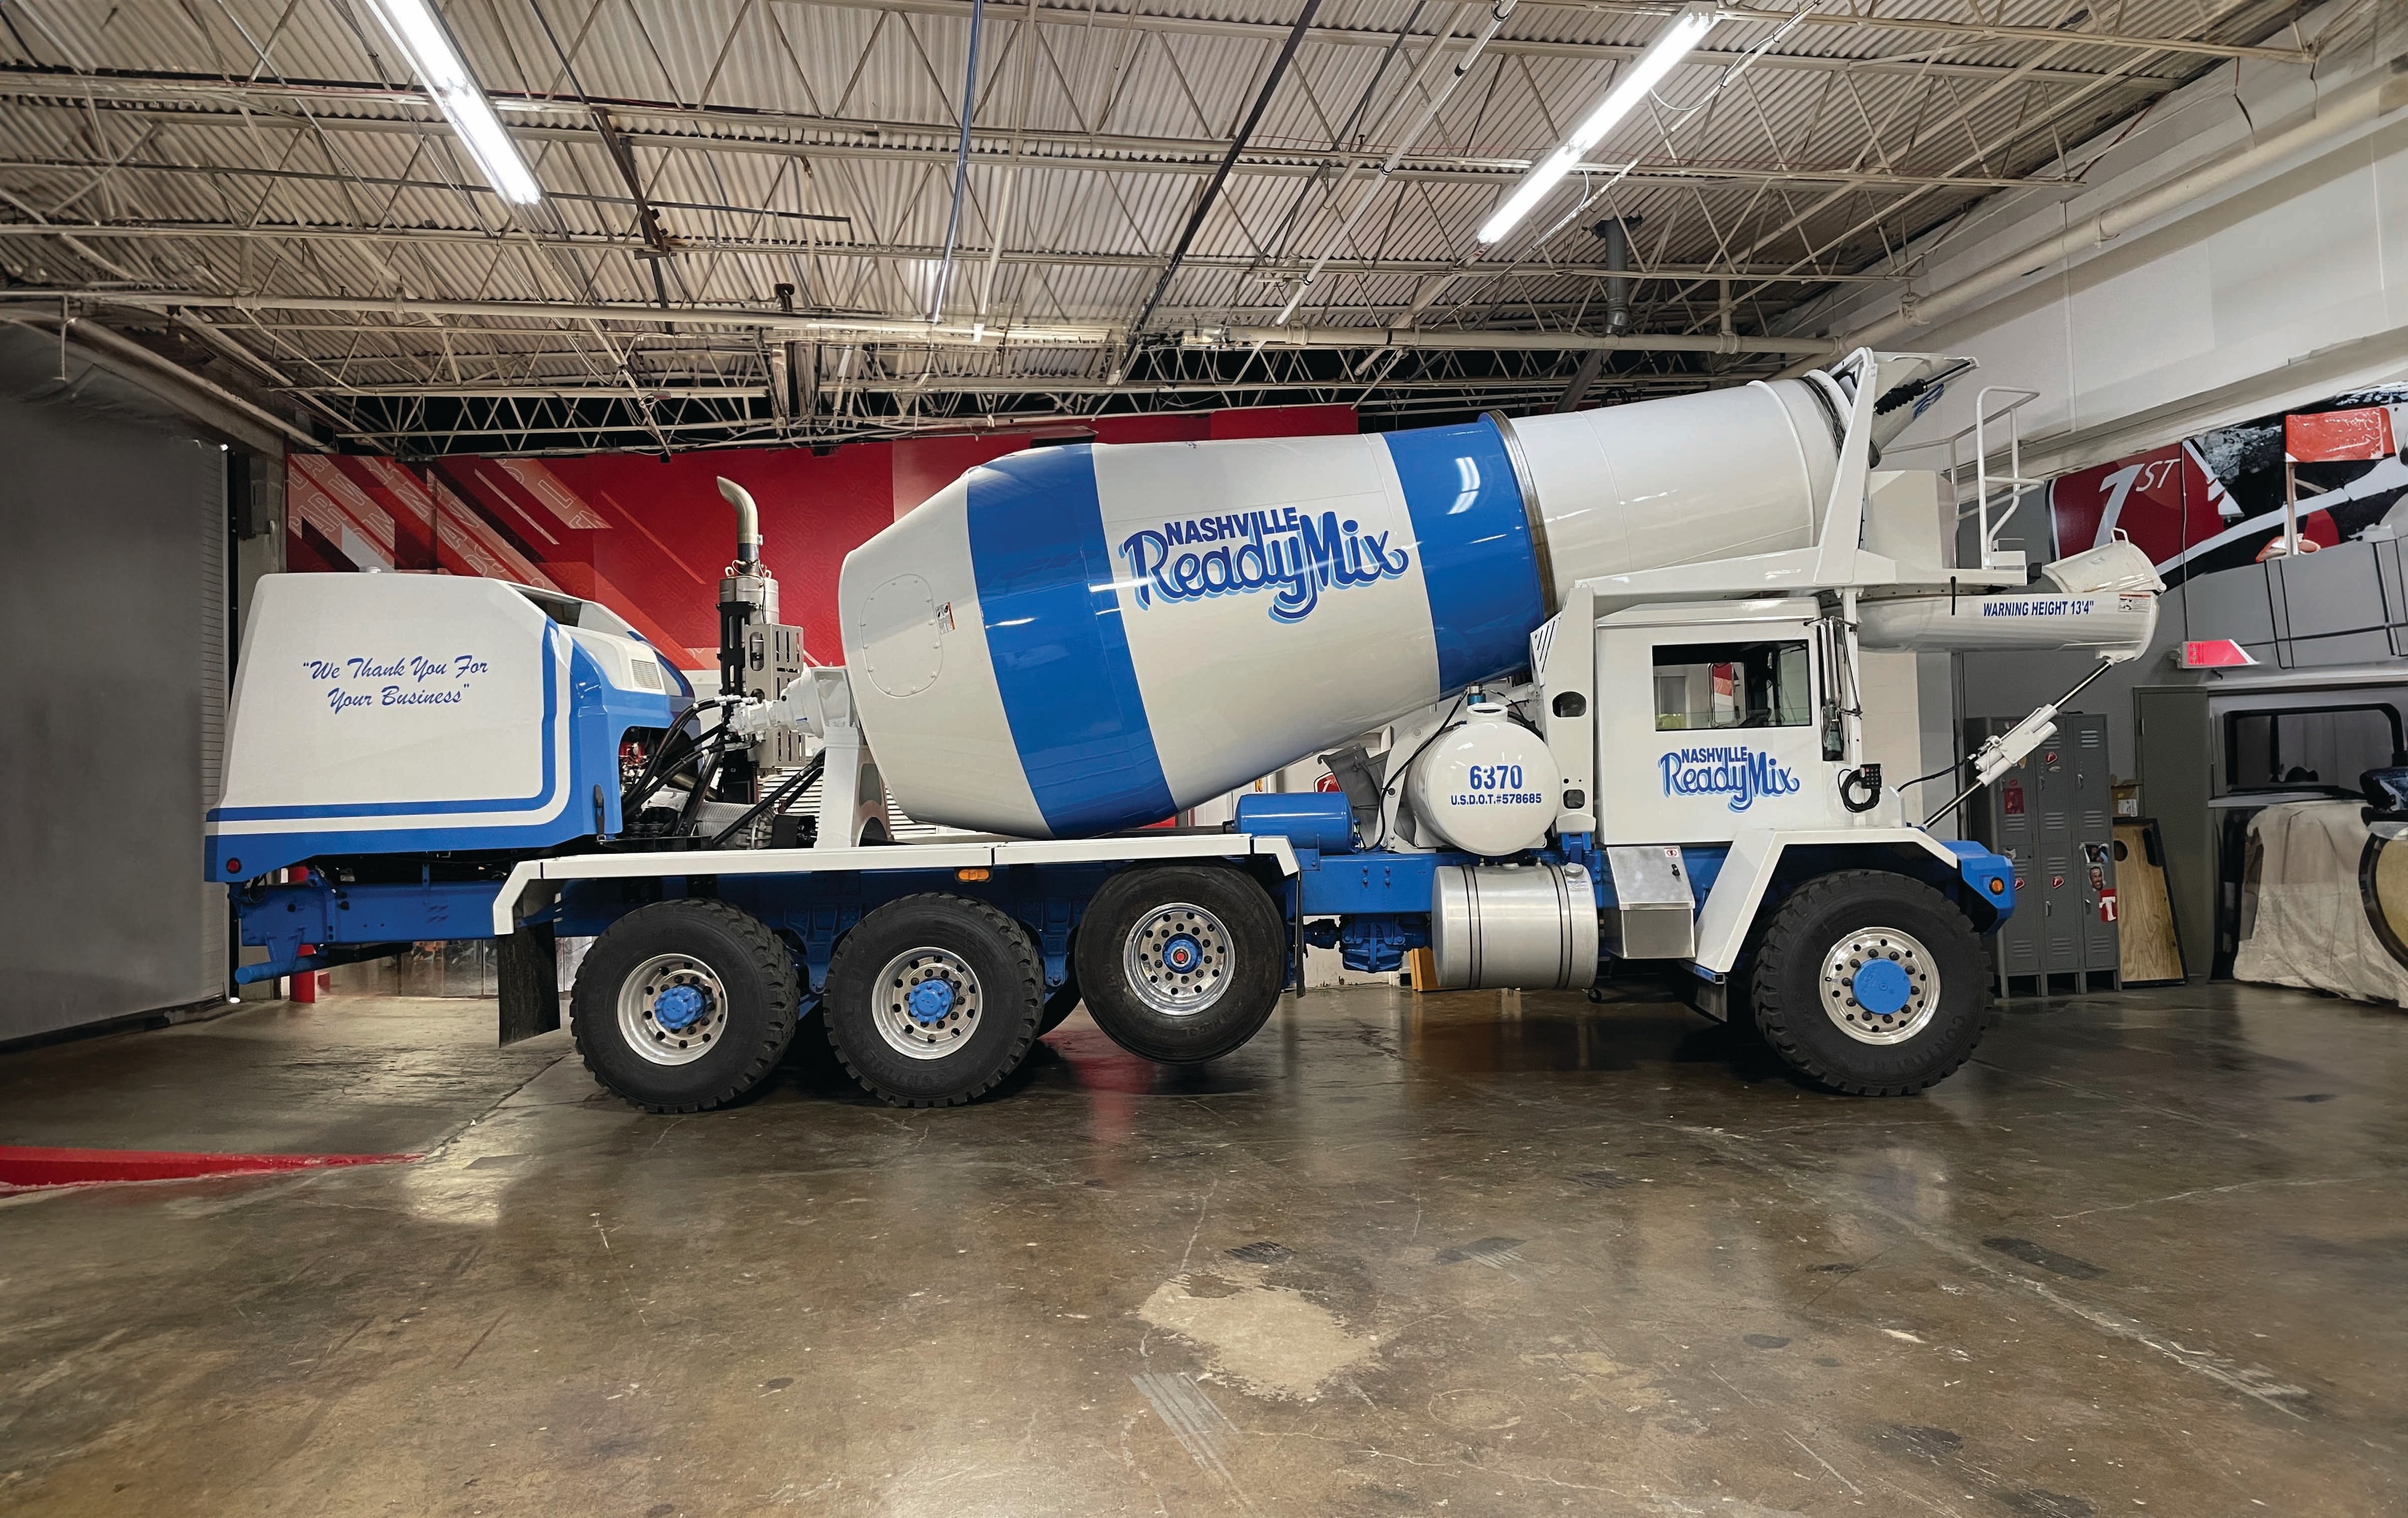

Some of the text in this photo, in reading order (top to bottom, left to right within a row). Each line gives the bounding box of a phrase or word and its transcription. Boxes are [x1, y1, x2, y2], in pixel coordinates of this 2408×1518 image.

[1164, 507, 1301, 547] NASHVILLE
[1983, 600, 2094, 616] WARNING HEIGHT 13'4"
[347, 656, 406, 679] Thank
[410, 655, 447, 683] You
[454, 655, 488, 678] For
[327, 687, 373, 715] Your
[1681, 746, 1748, 764] NASHVILLE
[1469, 765, 1523, 790] 6370
